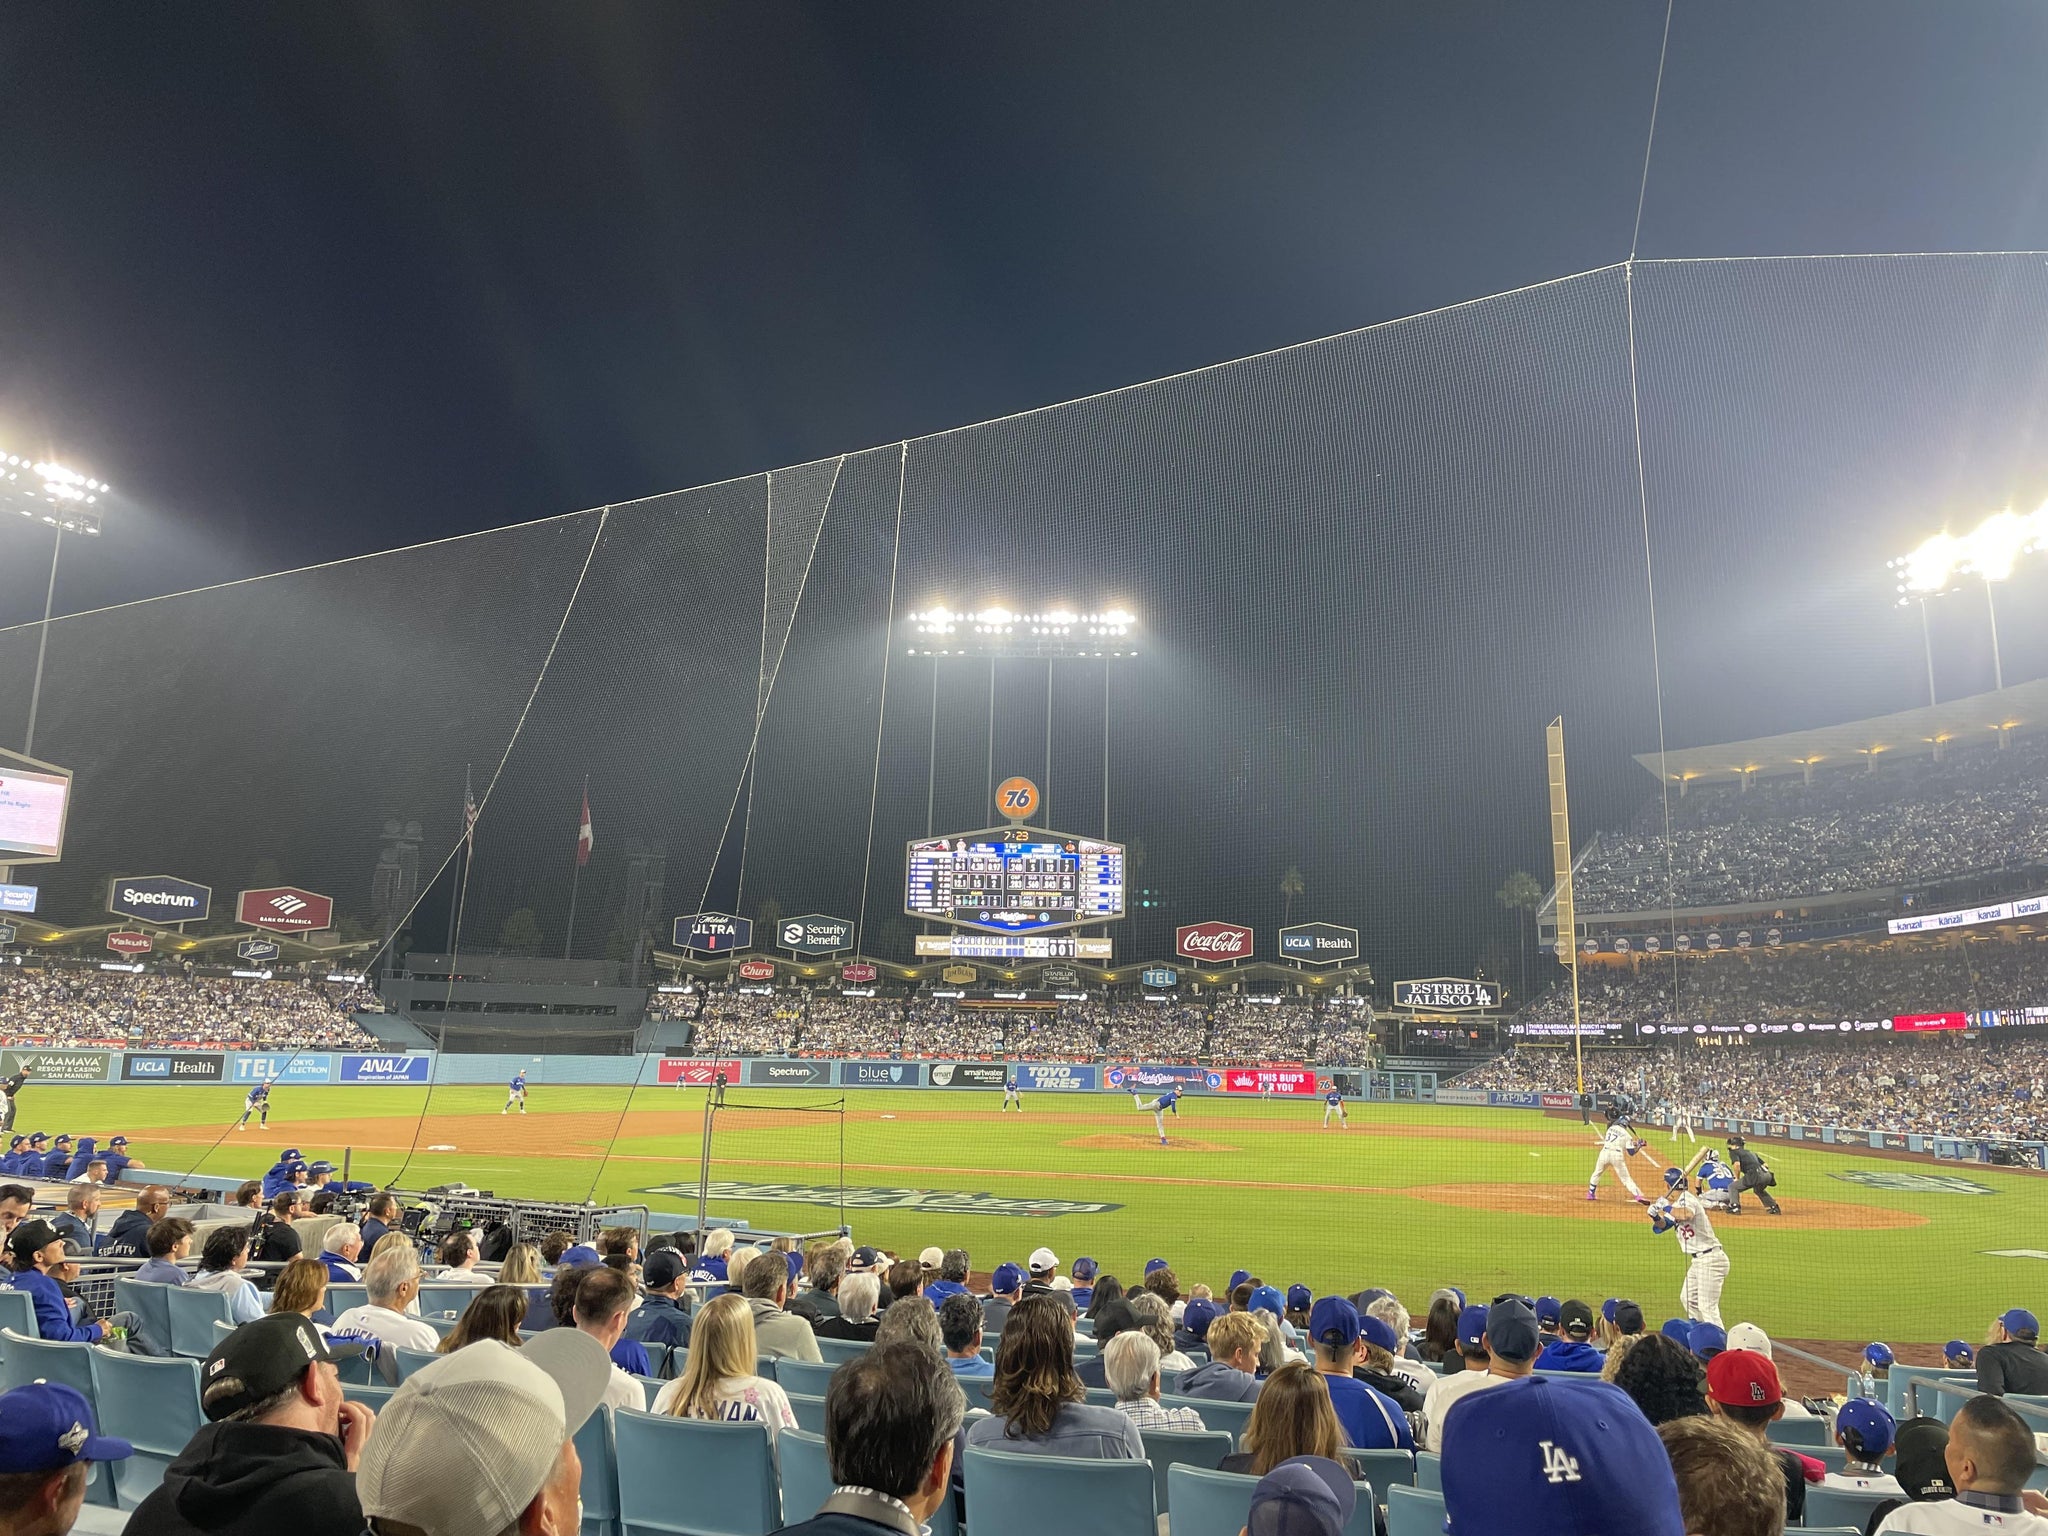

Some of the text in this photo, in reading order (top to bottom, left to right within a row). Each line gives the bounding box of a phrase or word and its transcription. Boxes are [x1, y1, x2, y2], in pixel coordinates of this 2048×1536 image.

[1004, 788, 1031, 808] 76
[1004, 831, 1029, 841] 7:23
[4, 889, 34, 901] Security
[123, 888, 195, 907] Spectrum
[692, 923, 735, 935] ULTRA
[806, 924, 847, 937] Security
[110, 937, 150, 947] Yakult
[806, 935, 841, 945] Benefit
[1183, 930, 1245, 952] Coca-Cola
[1285, 937, 1352, 949] UCLA Health
[741, 964, 773, 977] Churu
[945, 968, 974, 980] JIM BEAM
[1146, 972, 1172, 984] TEL
[1404, 994, 1473, 1006] JALISCO
[1509, 1024, 1525, 1034] 7:23
[135, 1061, 215, 1074] UCLA Health
[238, 1058, 280, 1078] TEL
[289, 1058, 315, 1066] TOKYO
[359, 1058, 394, 1073] ANA
[36, 1065, 67, 1073] RESORT
[289, 1066, 328, 1074] ELECTRON
[769, 1067, 810, 1077] Spectrum
[858, 1065, 889, 1079] blue
[963, 1068, 1004, 1076] smartwater
[1028, 1066, 1072, 1078] TOYO
[1035, 1077, 1082, 1089] TIRES
[1257, 1073, 1305, 1083] THIS BUD'S
[1257, 1082, 1294, 1092] FR YOU
[1319, 1081, 1331, 1089] 76
[1543, 1096, 1572, 1106] Yakult
[1605, 1133, 1618, 1143] 37
[694, 1269, 717, 1282] ANGELES
[1538, 1440, 1582, 1483] LA
